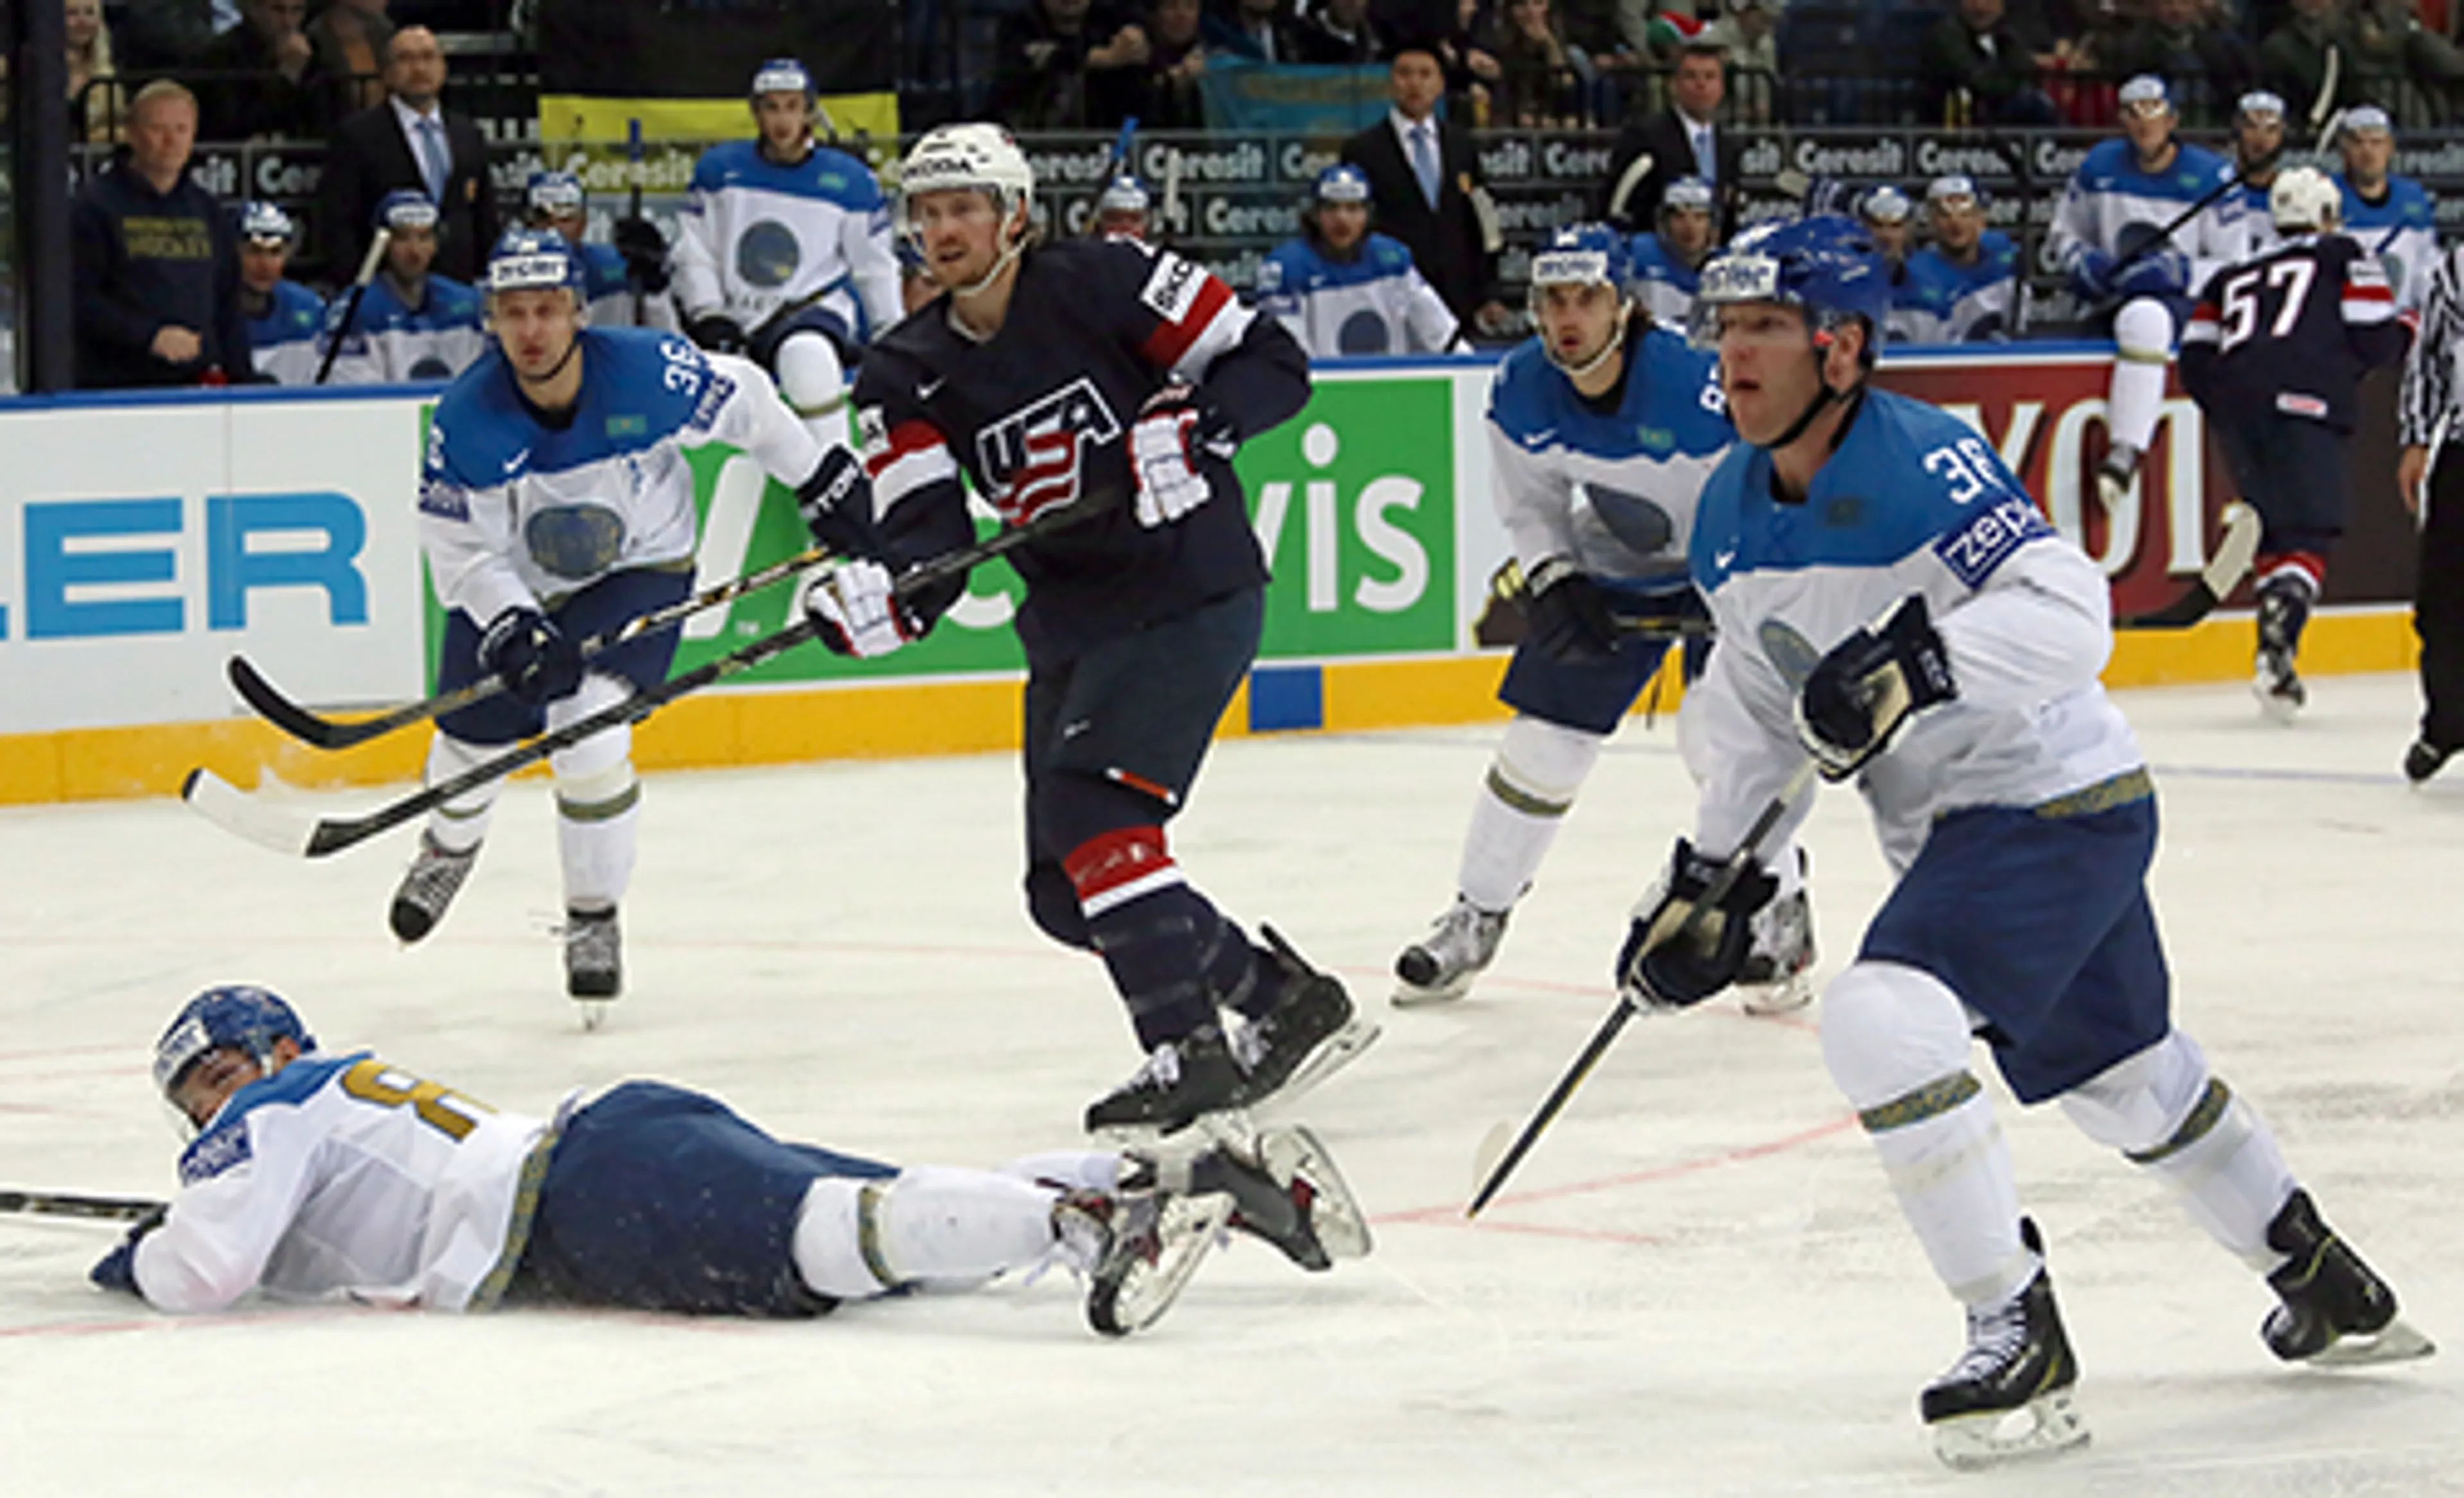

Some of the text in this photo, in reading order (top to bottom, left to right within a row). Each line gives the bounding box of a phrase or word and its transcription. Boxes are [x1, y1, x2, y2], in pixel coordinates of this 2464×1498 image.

[1144, 142, 1264, 179] Cresit
[2220, 257, 2317, 353] 57
[975, 377, 1121, 527] USA
[0, 491, 369, 640] ER
